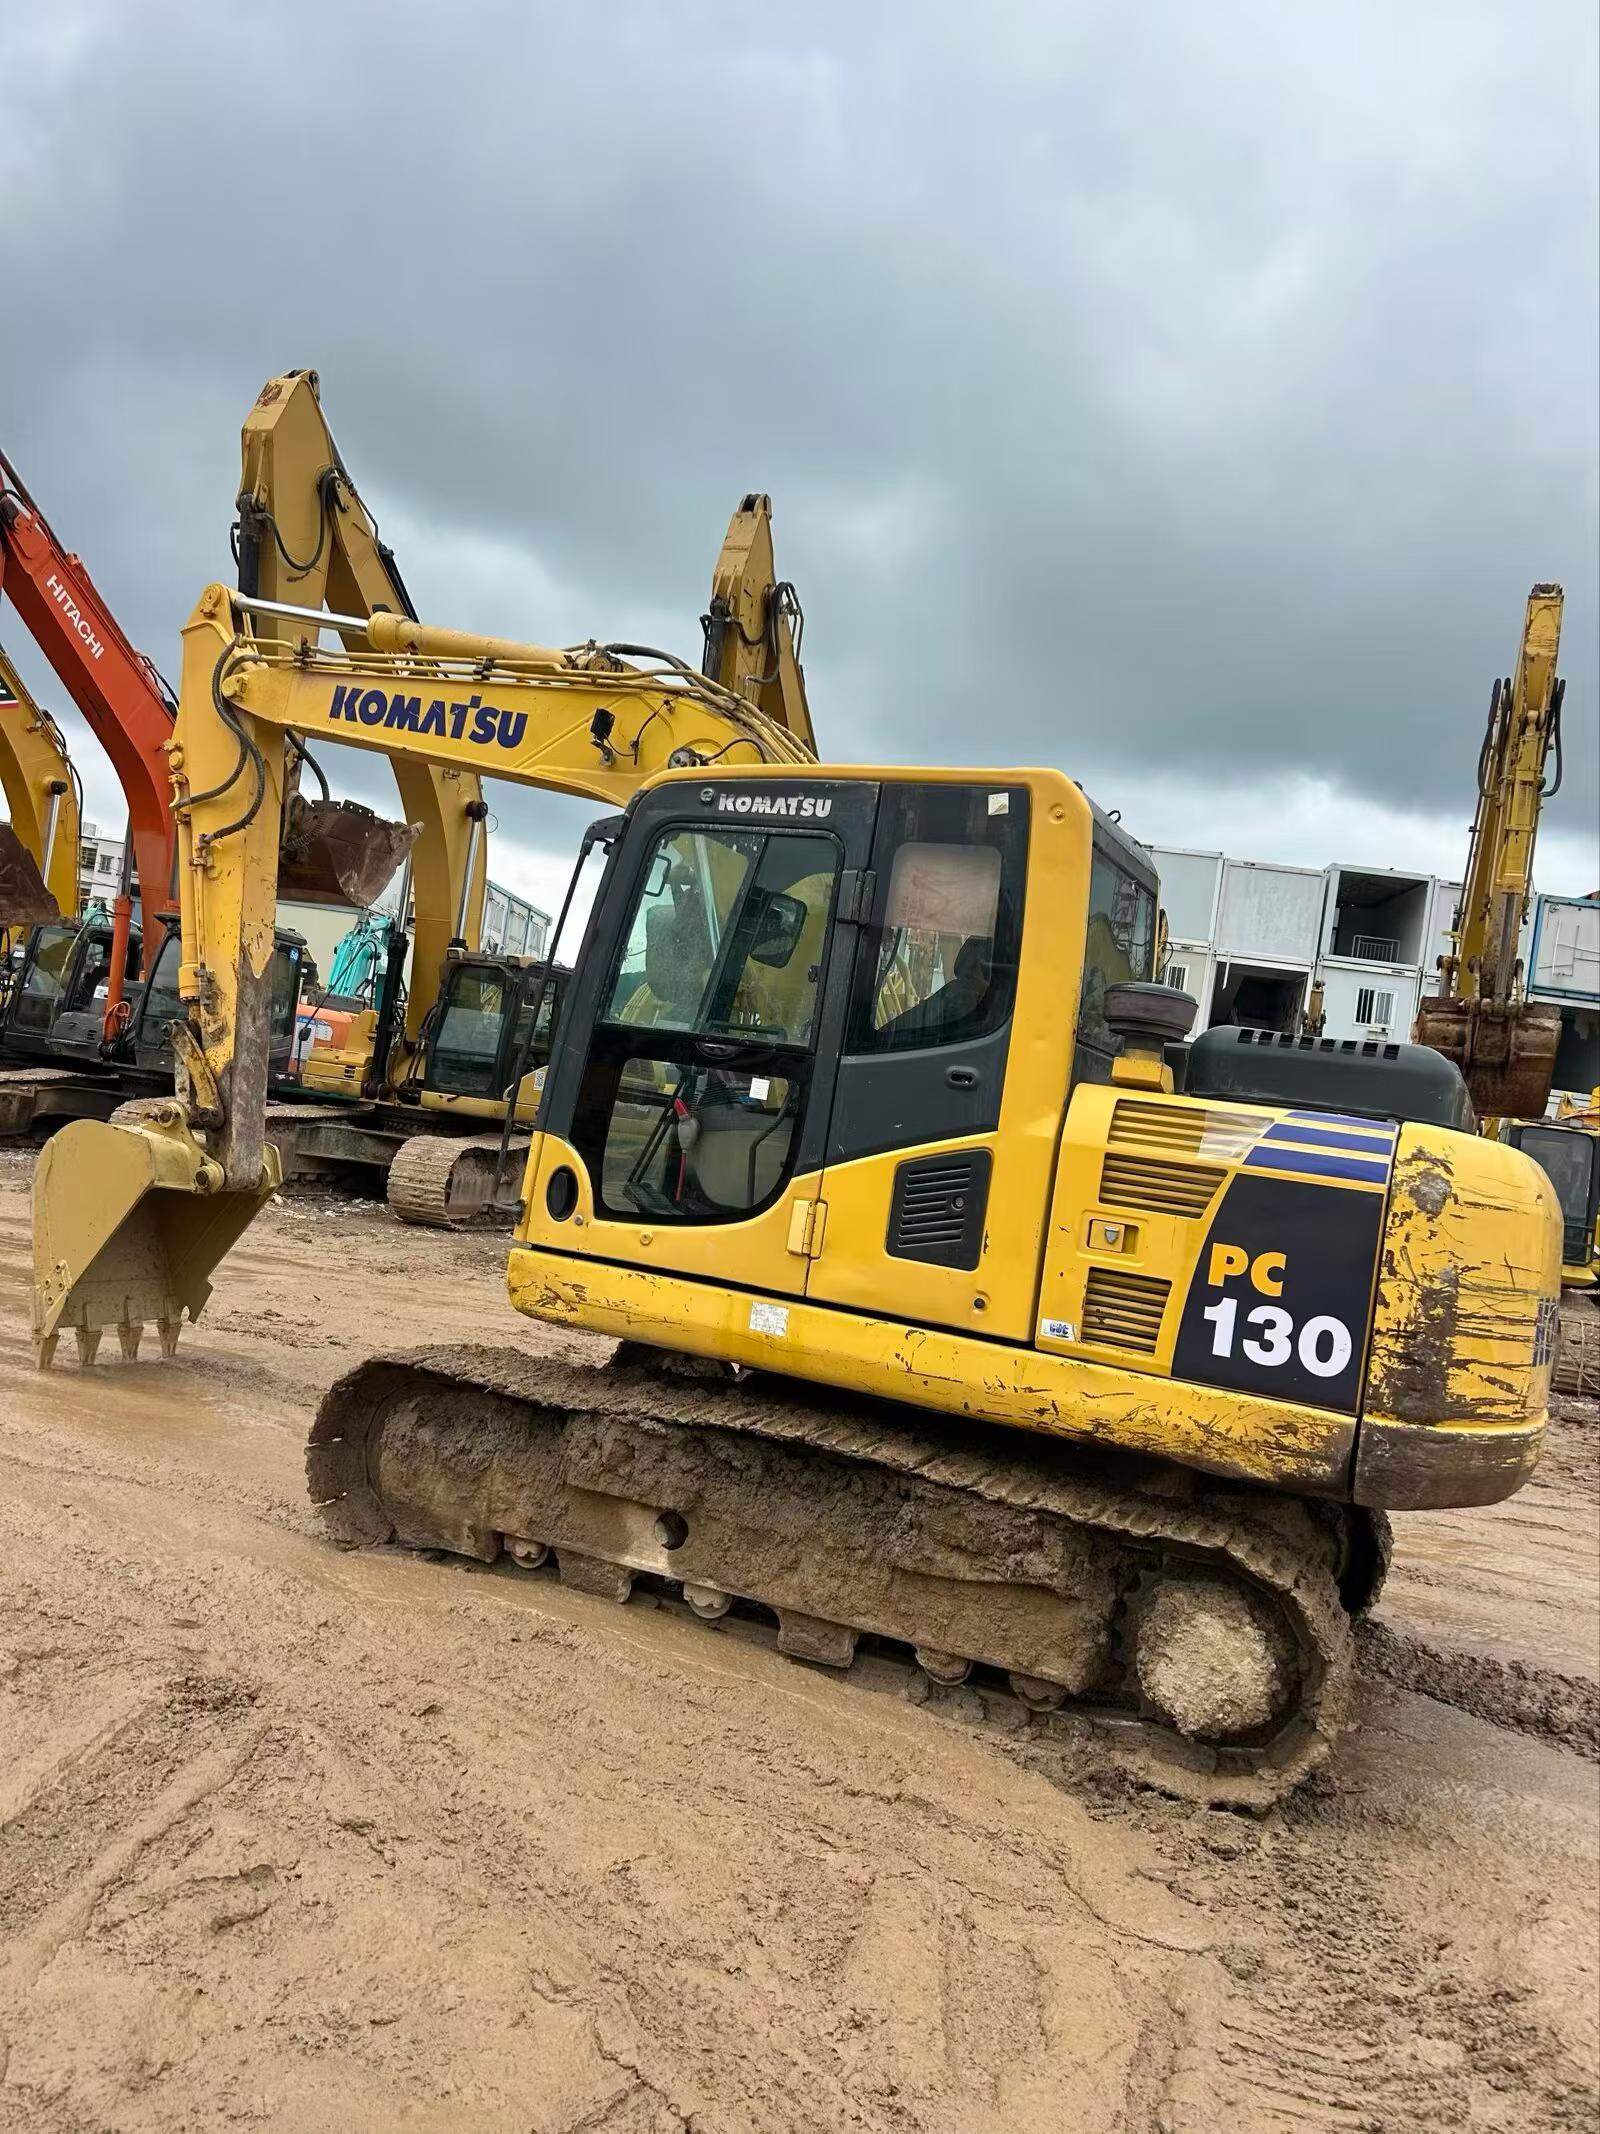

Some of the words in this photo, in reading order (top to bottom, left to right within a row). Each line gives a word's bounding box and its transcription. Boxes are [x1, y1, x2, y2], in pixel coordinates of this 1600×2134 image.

[46, 574, 105, 659] HITACHI
[329, 685, 529, 749] KOMATSU
[718, 793, 832, 817] KOMATSU
[1208, 1242, 1287, 1297] PC
[1203, 1297, 1353, 1378] 130
